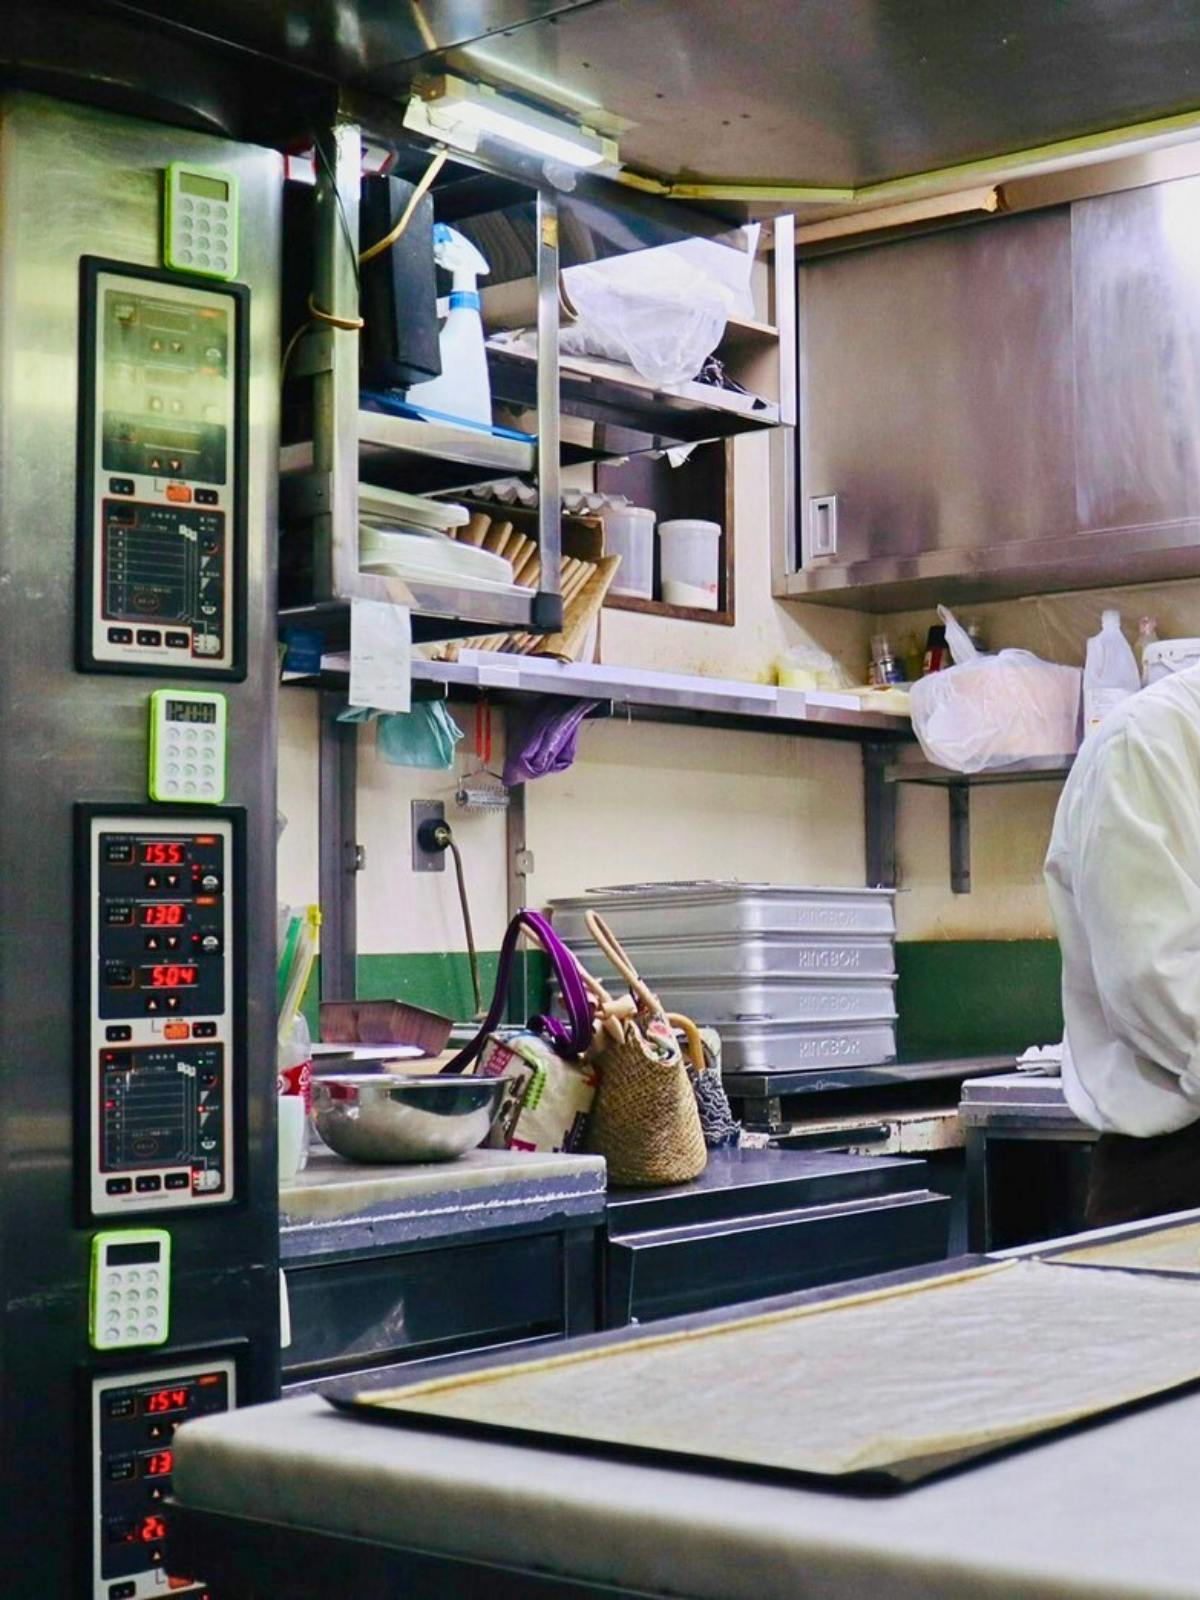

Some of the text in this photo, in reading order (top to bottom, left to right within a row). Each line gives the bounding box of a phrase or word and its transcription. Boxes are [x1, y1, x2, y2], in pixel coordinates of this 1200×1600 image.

[145, 843, 182, 865] 155
[145, 903, 182, 925] 130
[151, 964, 196, 987] 504
[147, 1388, 188, 1412] 154
[148, 1450, 174, 1474] 13
